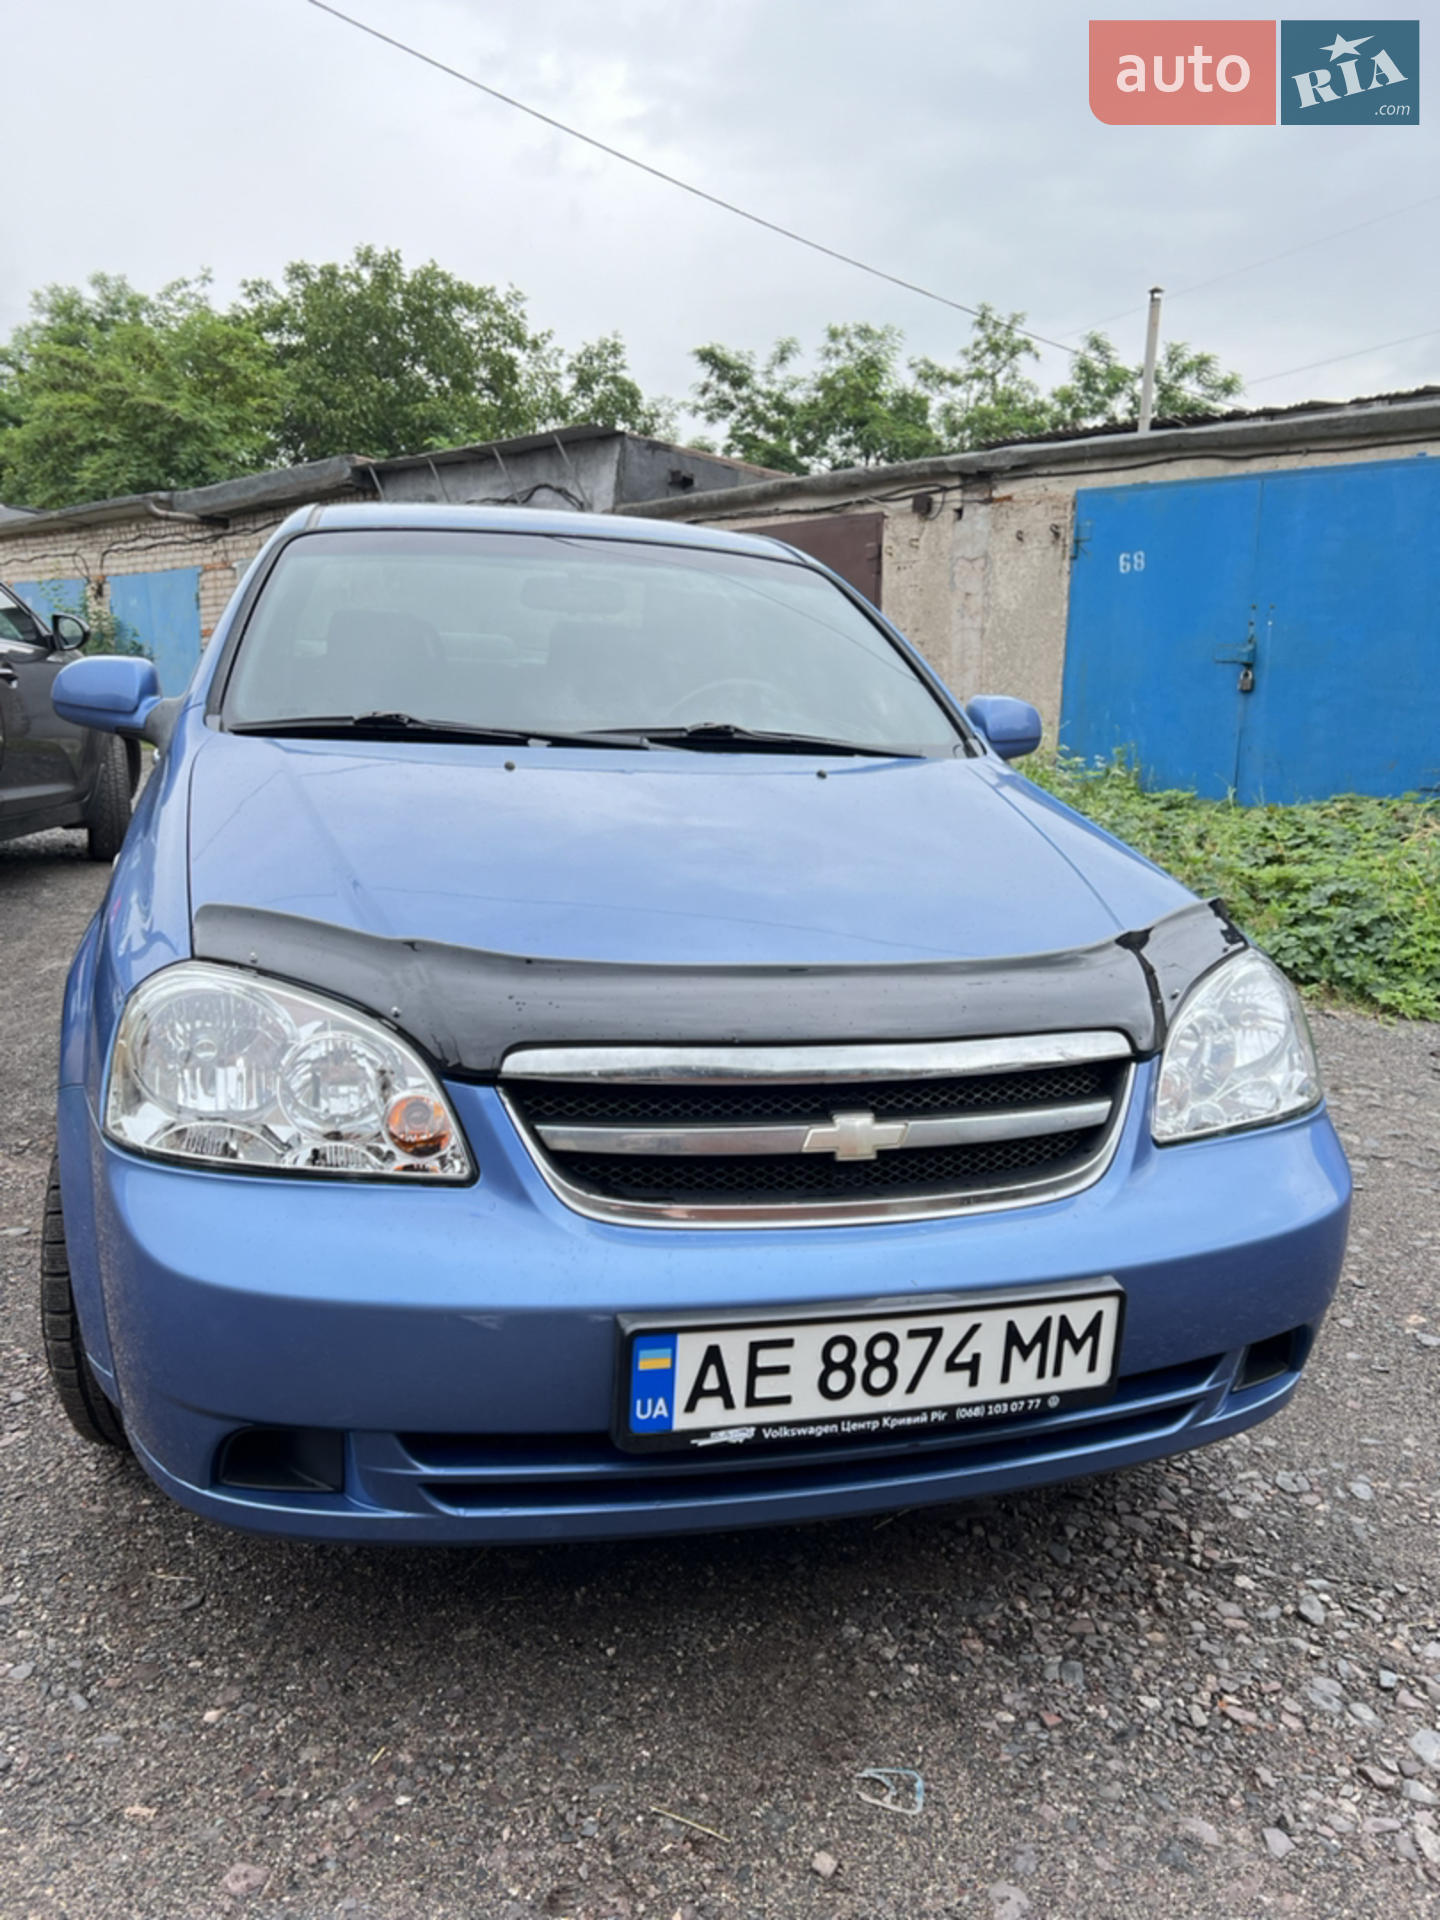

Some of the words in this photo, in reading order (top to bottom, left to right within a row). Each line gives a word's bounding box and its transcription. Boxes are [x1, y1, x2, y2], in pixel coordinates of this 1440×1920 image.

[1119, 550, 1145, 573] 68
[683, 1337, 795, 1414] AE
[817, 1322, 983, 1401] 8874
[999, 1309, 1104, 1386] MM
[635, 1397, 669, 1420] UA
[762, 1424, 838, 1438] Volkswagen
[841, 1419, 879, 1433] Центр
[882, 1411, 928, 1428] Кривий
[930, 1409, 949, 1422] Ріг
[955, 1404, 986, 1420] (068)
[987, 1402, 1009, 1415] 103
[1010, 1400, 1025, 1413] 07
[1027, 1398, 1042, 1410] 77
